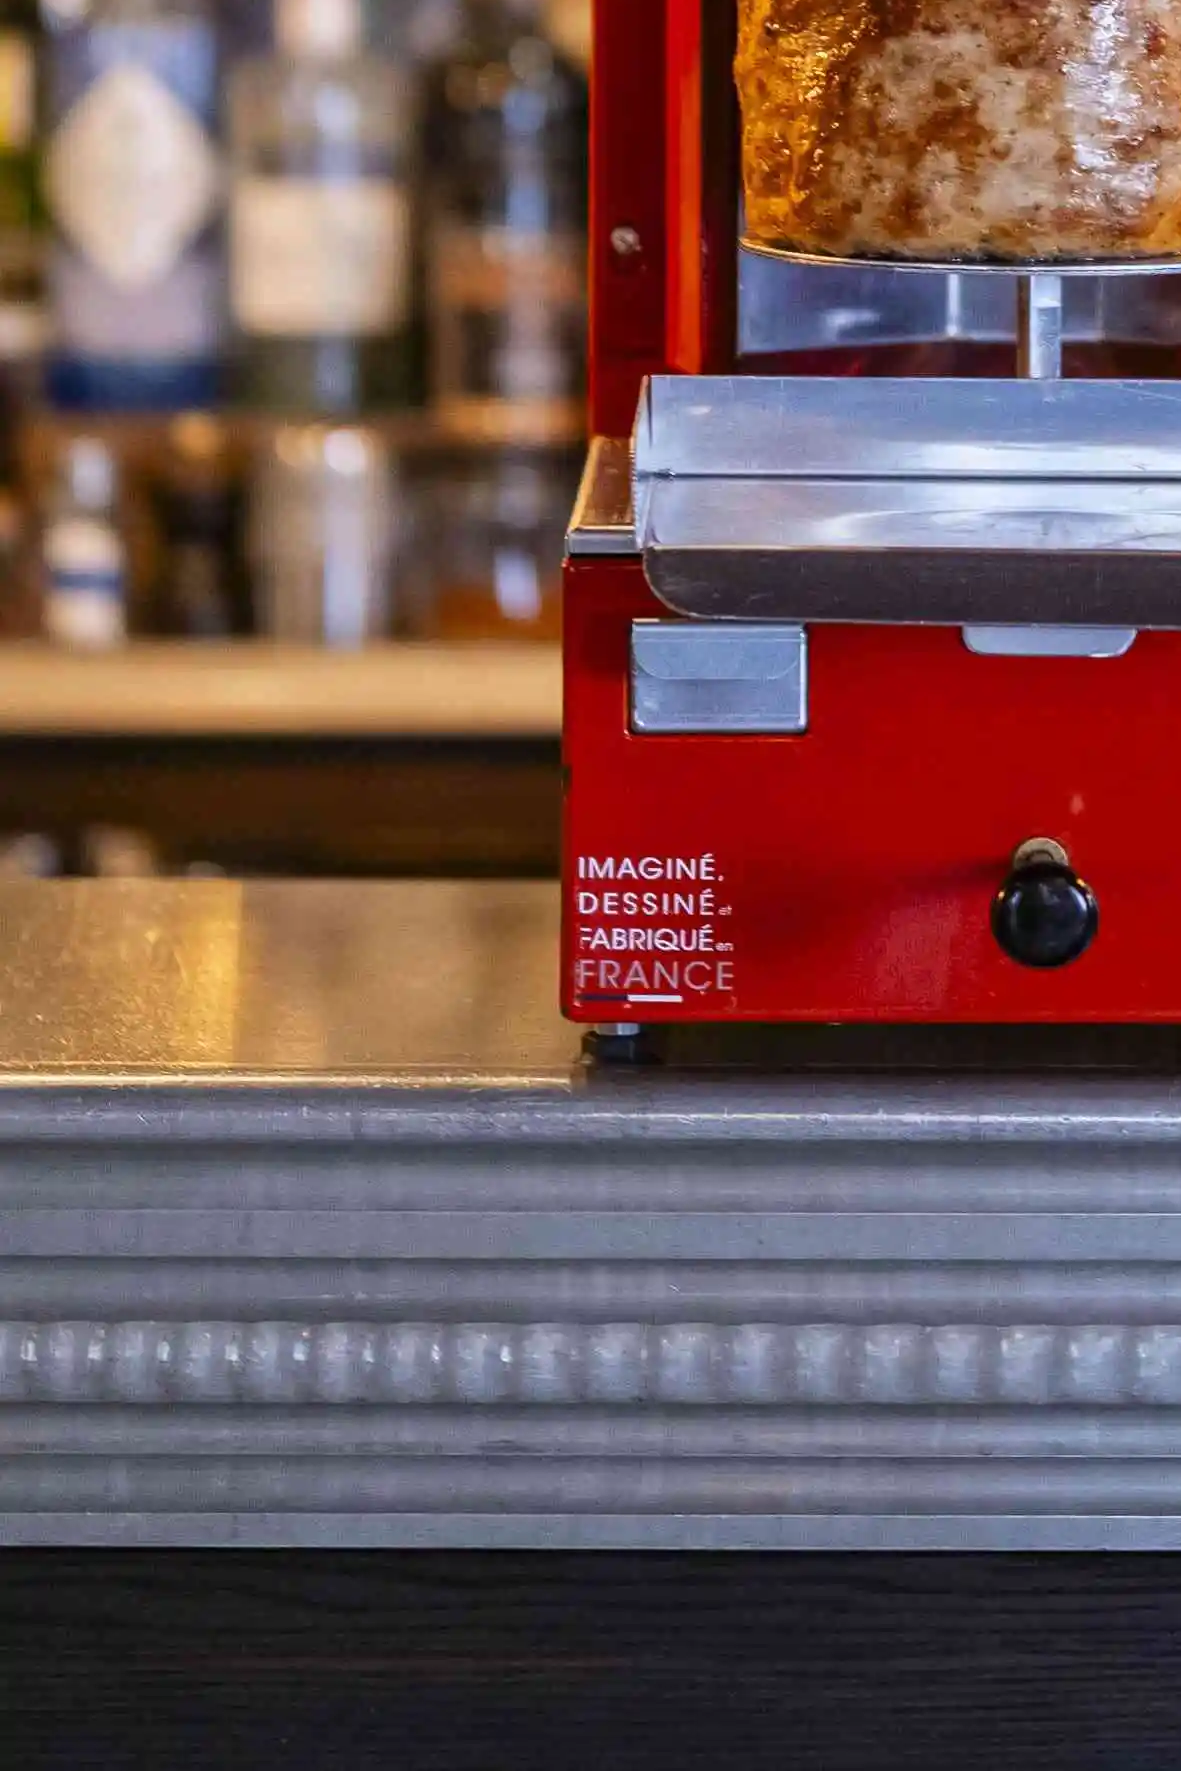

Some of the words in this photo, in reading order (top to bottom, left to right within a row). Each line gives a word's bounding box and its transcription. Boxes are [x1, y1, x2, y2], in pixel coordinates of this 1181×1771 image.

[578, 888, 715, 916] DESSINÉ
[718, 904, 733, 916] et
[579, 923, 715, 951] FABRIQUÉ
[715, 942, 734, 952] en
